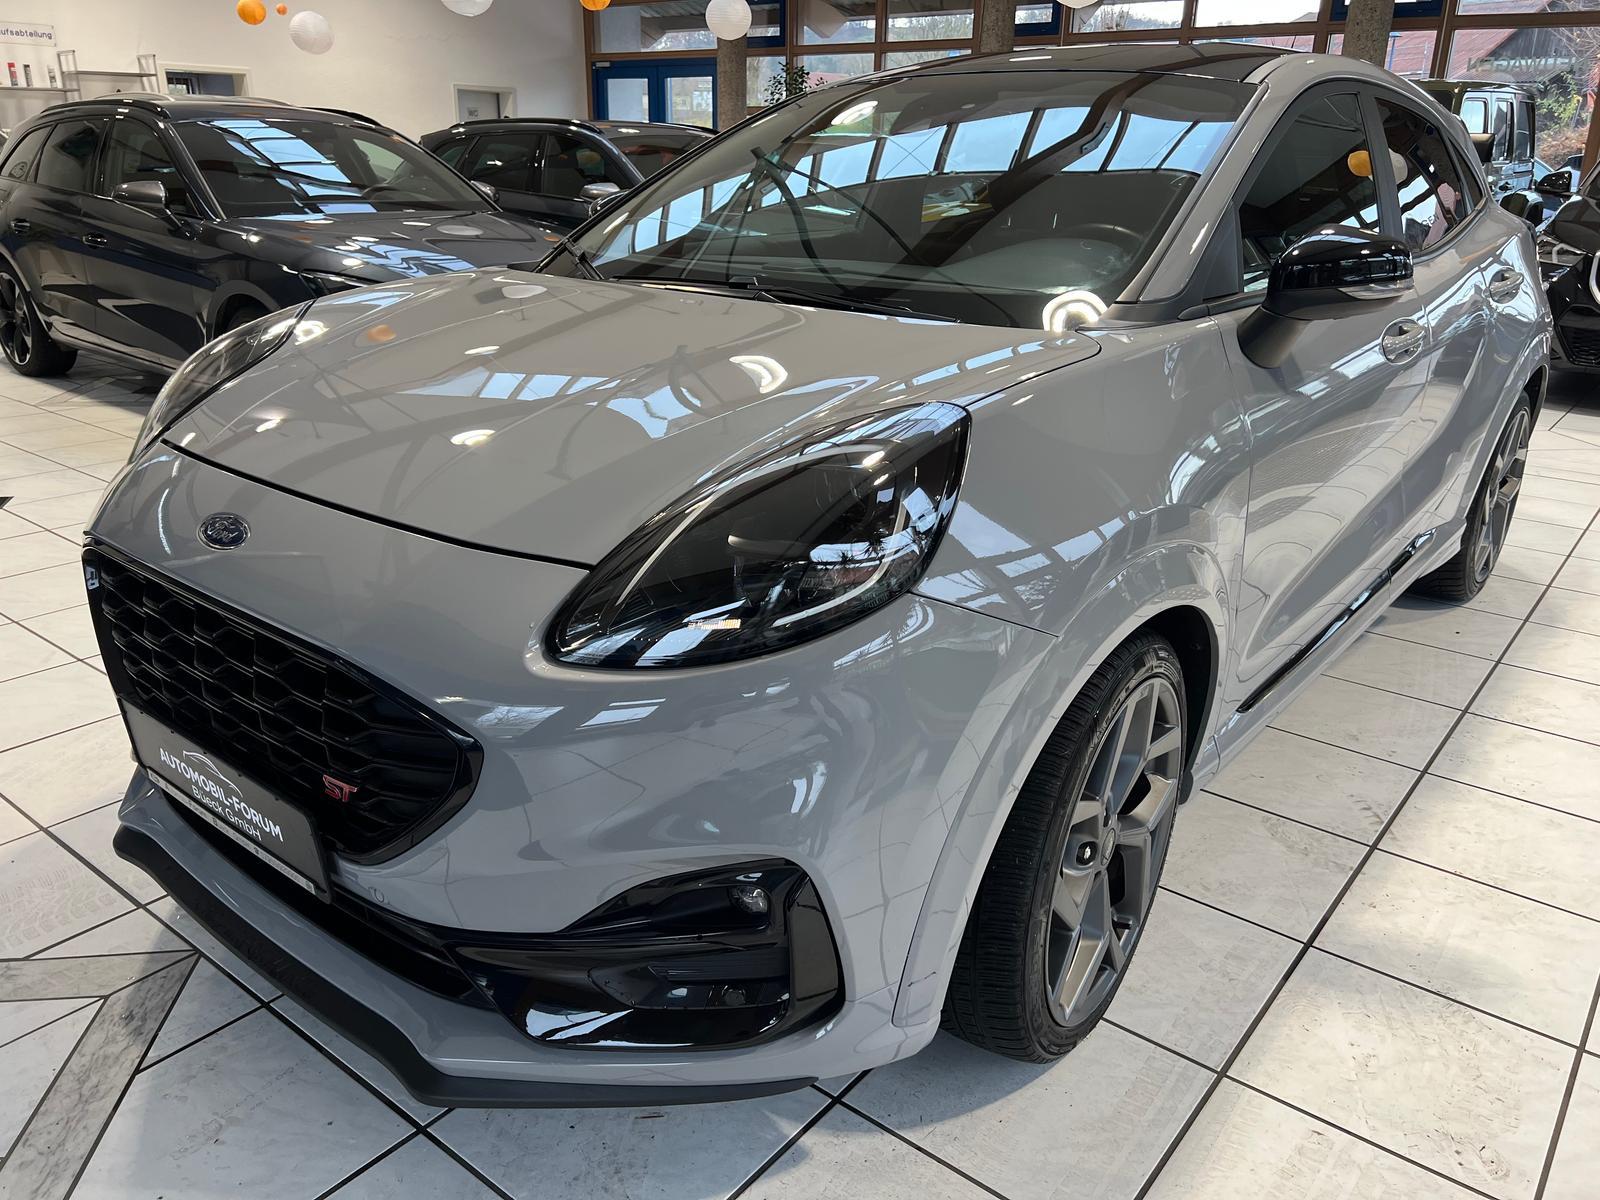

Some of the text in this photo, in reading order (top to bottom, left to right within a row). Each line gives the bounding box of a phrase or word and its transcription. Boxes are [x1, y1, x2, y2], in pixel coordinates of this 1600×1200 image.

[206, 519, 240, 542] Ford
[160, 747, 284, 842] AUTOMOBIL-FORUM
[323, 774, 358, 802] ST
[225, 809, 262, 841] GmbH
